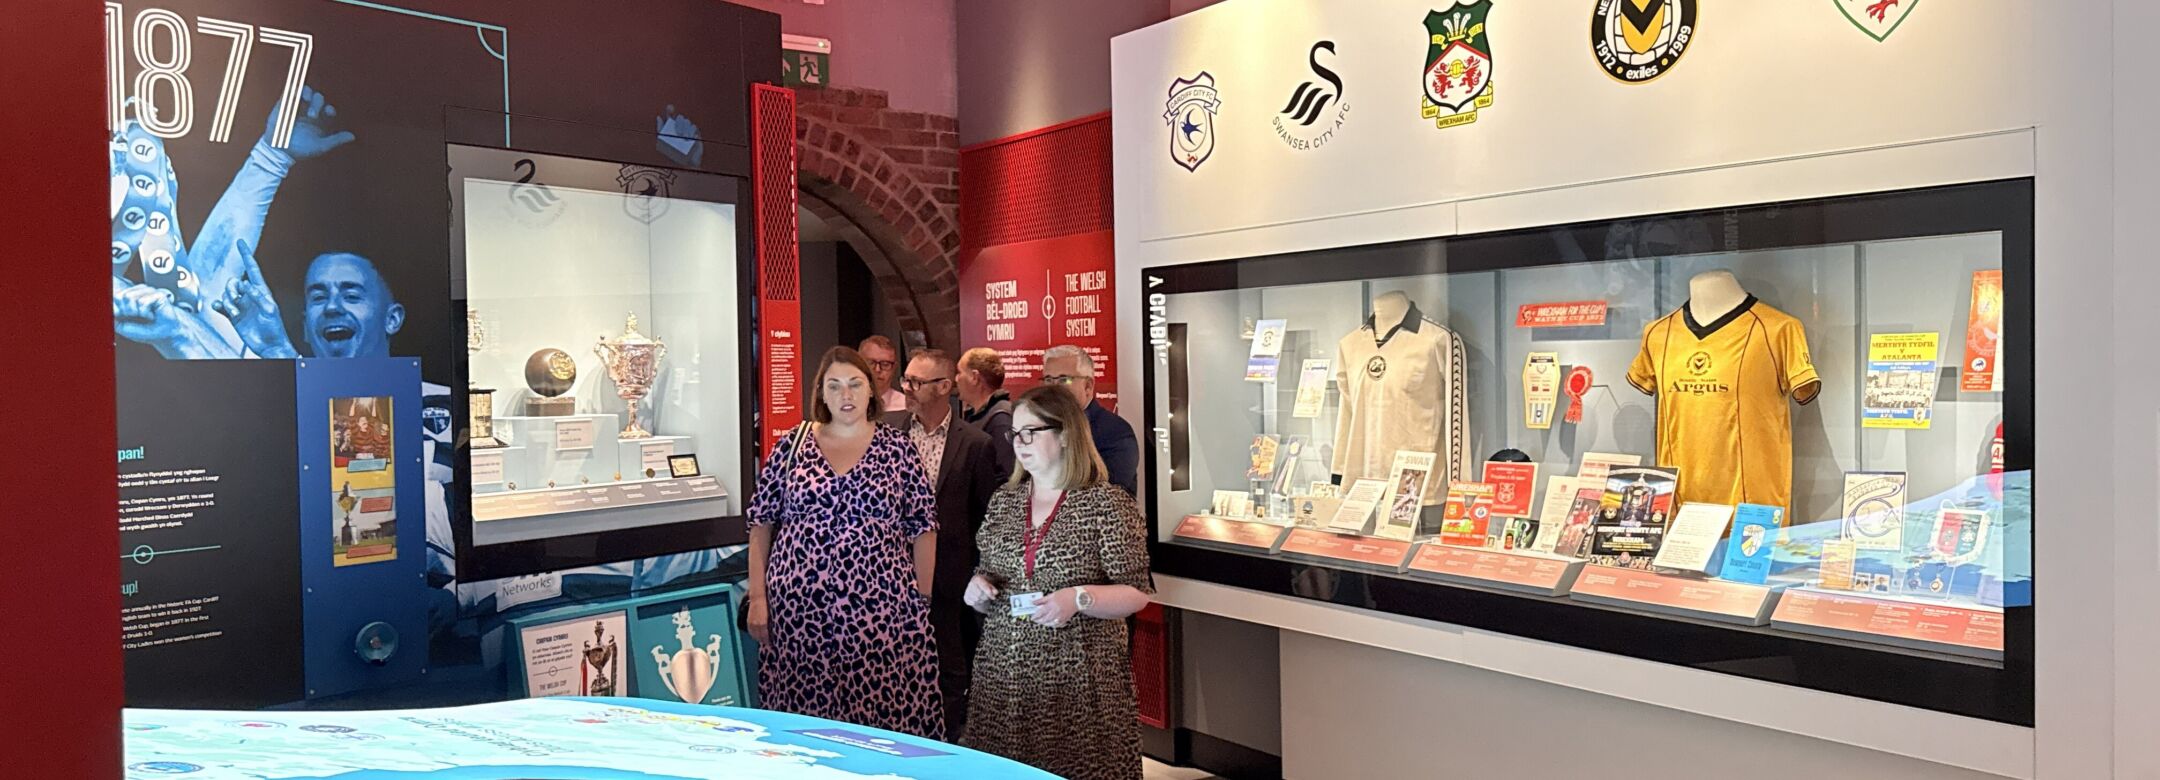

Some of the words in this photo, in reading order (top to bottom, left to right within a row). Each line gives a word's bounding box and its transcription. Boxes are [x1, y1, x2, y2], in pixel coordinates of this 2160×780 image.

[1596, 40, 1616, 70] 1912
[1626, 65, 1658, 79] exiles
[1668, 26, 1691, 57] 1989
[105, 2, 312, 148] 1877
[1170, 91, 1192, 109] CARDIFF
[1193, 89, 1205, 97] CITY
[1206, 91, 1214, 100] FC
[1273, 116, 1310, 150] SWANSEA
[1313, 127, 1333, 148] CITY
[1335, 102, 1351, 130] AFC
[1439, 115, 1464, 126] WREXHAM
[1465, 114, 1475, 122] AFC
[986, 280, 1017, 300] SYSTEM
[1065, 273, 1079, 293] THE
[1080, 270, 1106, 291] WELSH
[986, 301, 1028, 320] BÊL-DROED
[1066, 294, 1101, 315] FOOTBALL
[1537, 305, 1568, 316] WREXHAM
[987, 324, 1014, 341] CYMRU
[1066, 318, 1096, 338] SYSTEM
[1669, 381, 1729, 397] Argus
[118, 446, 144, 463] pan!
[502, 577, 551, 596] Networks
